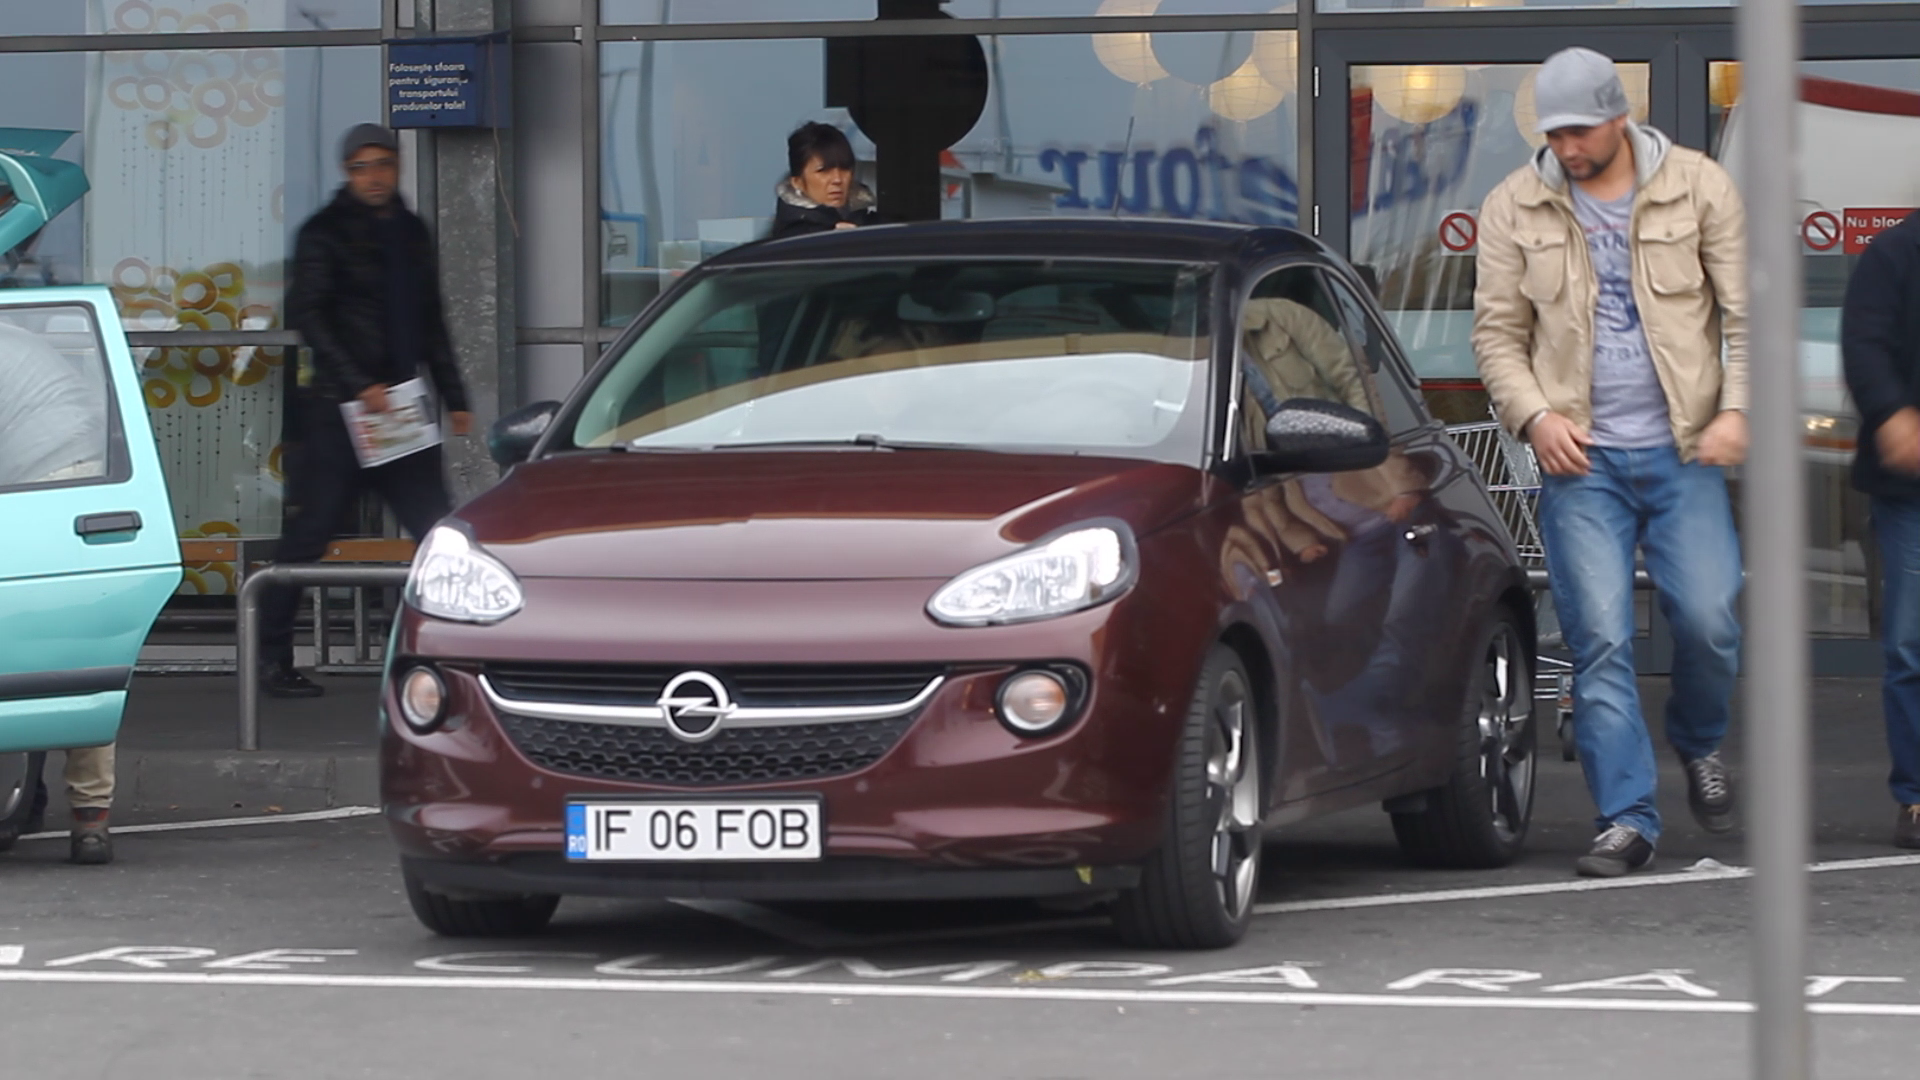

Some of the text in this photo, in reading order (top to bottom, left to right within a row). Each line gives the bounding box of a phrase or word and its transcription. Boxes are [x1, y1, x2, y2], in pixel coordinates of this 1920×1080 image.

[389, 77, 420, 87] pentru
[399, 88, 459, 99] transportului
[1845, 216, 1868, 229] Nu
[568, 809, 810, 852] RO IF 06 FOB
